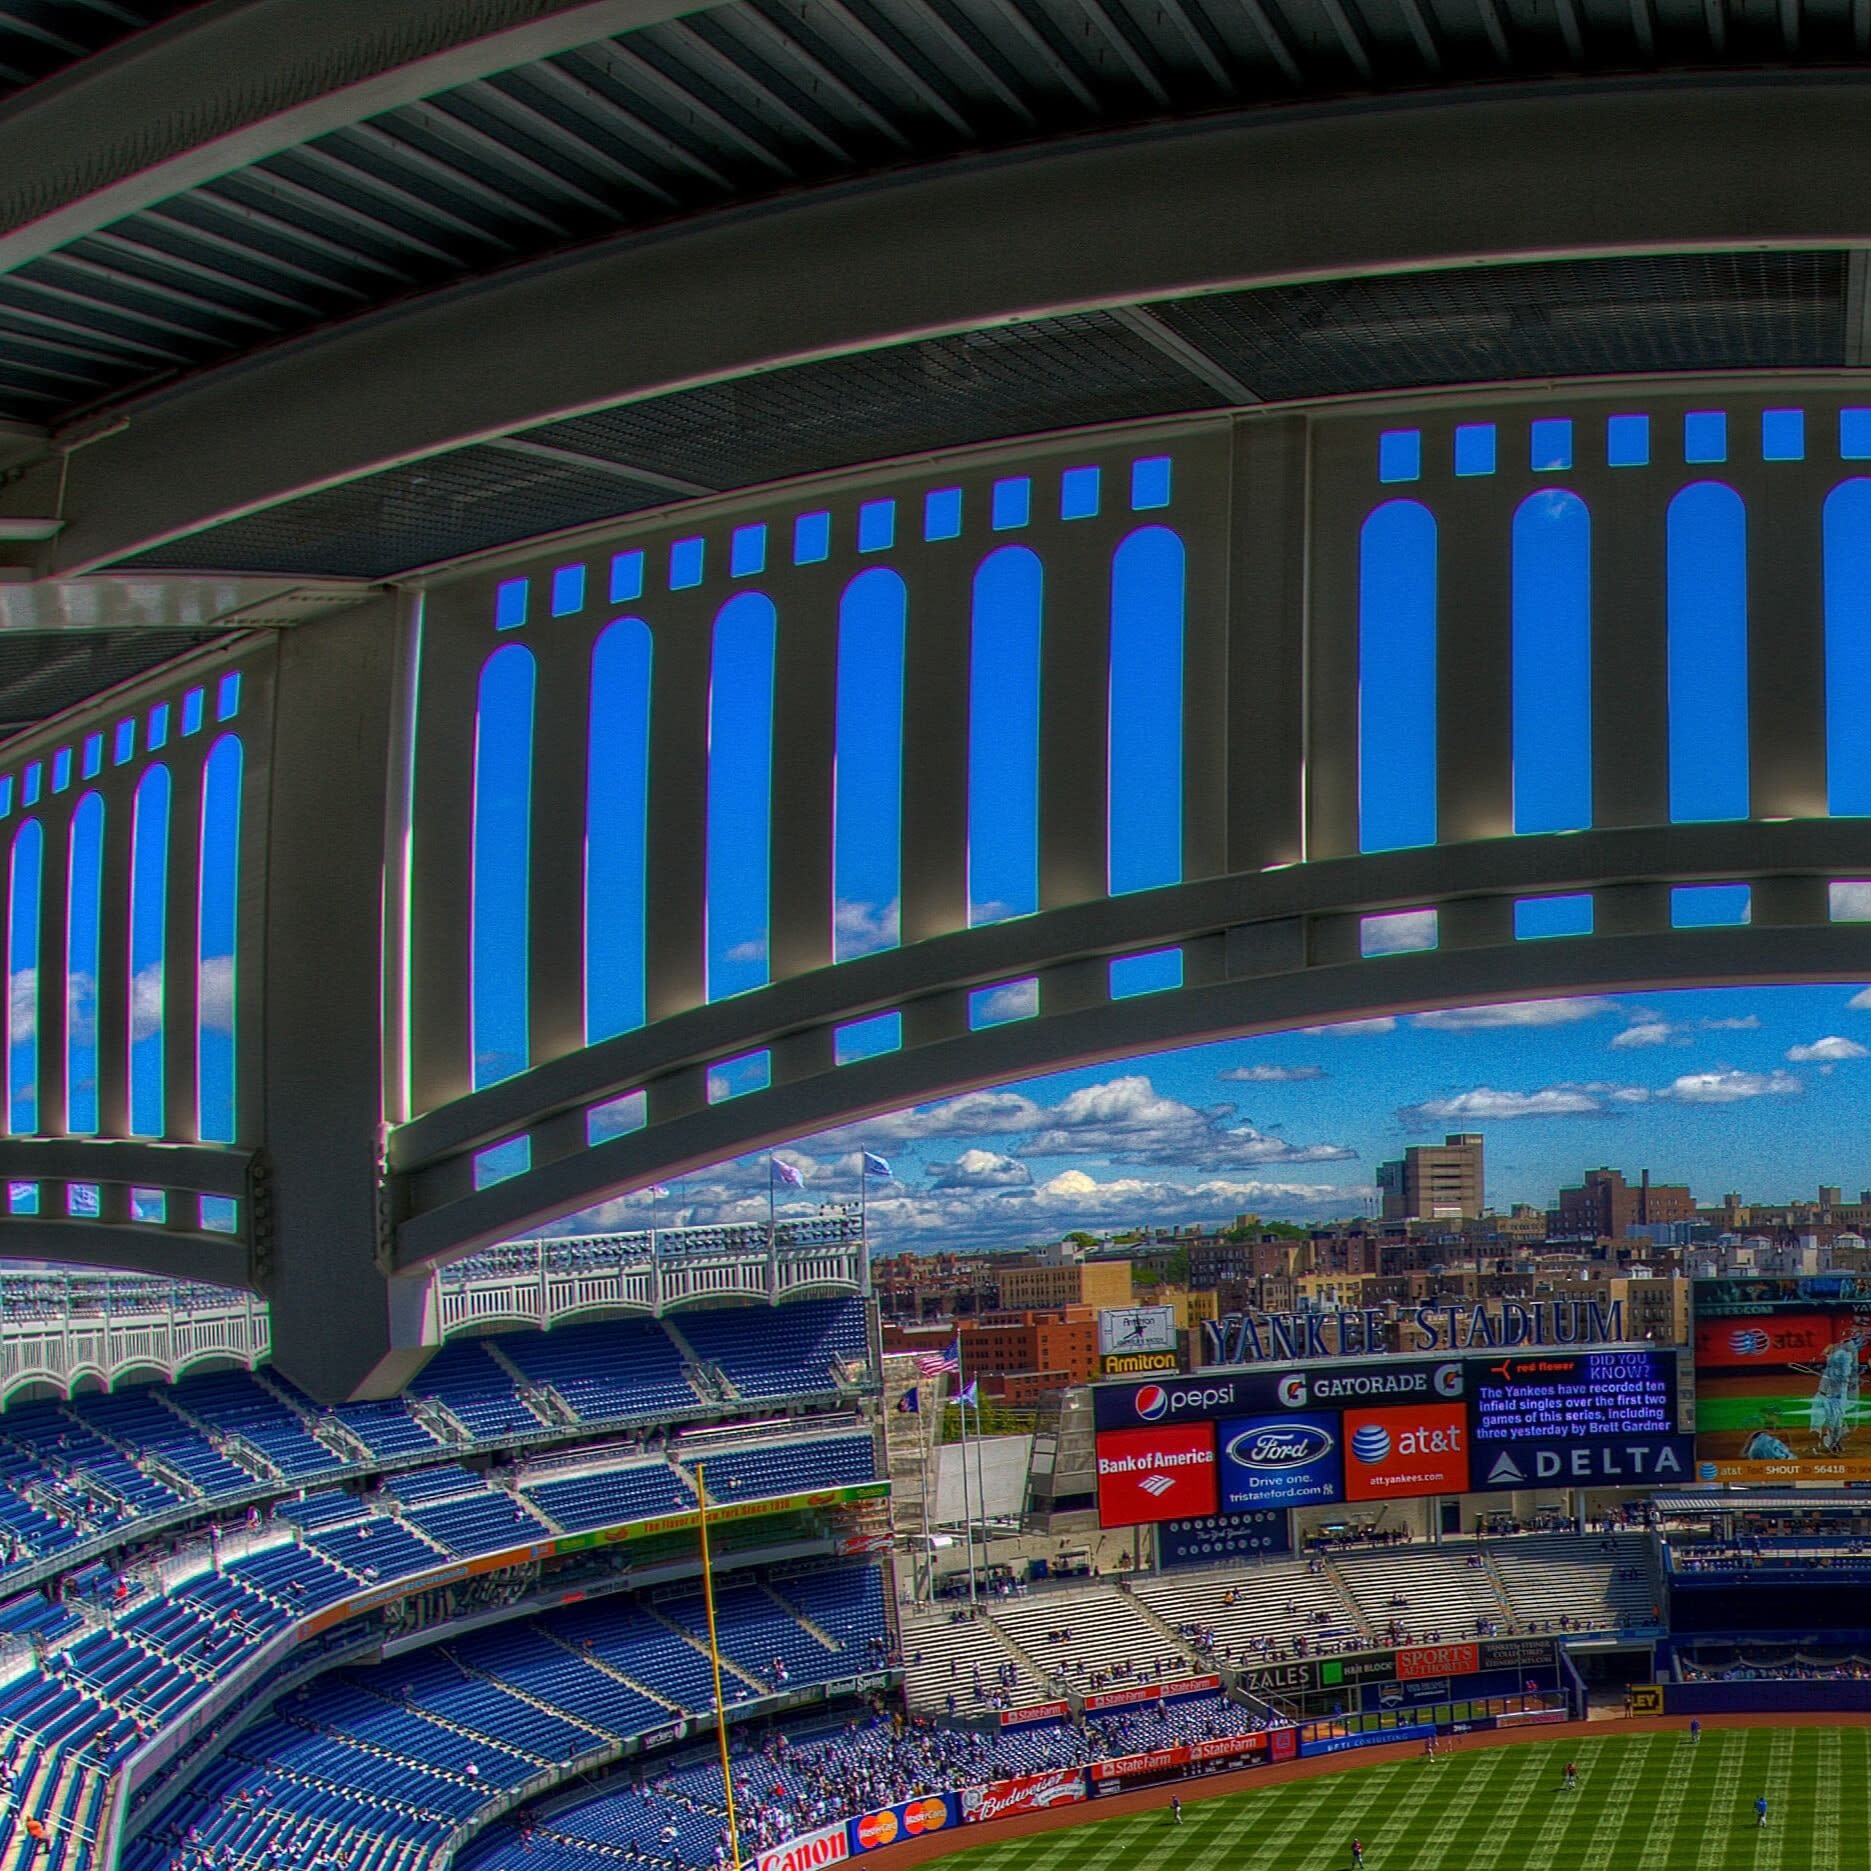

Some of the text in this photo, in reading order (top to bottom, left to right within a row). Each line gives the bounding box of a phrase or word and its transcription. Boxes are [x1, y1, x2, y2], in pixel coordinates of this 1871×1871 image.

[1202, 1299, 1625, 1365] YANKEE STADIUM
[1105, 1354, 1175, 1373] Armitron
[1517, 1362, 1536, 1373] red
[1589, 1353, 1648, 1366] DID YOU
[1590, 1364, 1650, 1380] KNOW?
[1313, 1374, 1427, 1398] GATORADE
[1480, 1381, 1665, 1398] The Yankees have recorded ten
[1171, 1384, 1234, 1411] pepsi
[1479, 1395, 1667, 1412] infield singles over the first two
[1482, 1414, 1522, 1428] games
[1524, 1412, 1537, 1423] of
[1540, 1410, 1562, 1422] this
[1608, 1407, 1664, 1421] including
[1399, 1424, 1461, 1455] at&t
[1477, 1420, 1672, 1440] three yesterday by Brett Gardner
[1251, 1433, 1309, 1461] Ford
[1099, 1448, 1214, 1475] Bank of America
[1536, 1446, 1682, 1478] DELTA
[1766, 1465, 1801, 1475] SHOUT
[1813, 1464, 1846, 1475] 56418
[1249, 1474, 1313, 1488] Drive one.
[1370, 1472, 1444, 1486] att.yankees.com
[1229, 1486, 1321, 1503] tristateford.com
[1401, 1645, 1473, 1666] SPORTS
[1364, 1661, 1393, 1673] BLOCK
[1402, 1660, 1473, 1677] AUTHORITY
[1249, 1665, 1310, 1691] ZALES
[980, 1771, 1065, 1820] Budweiser
